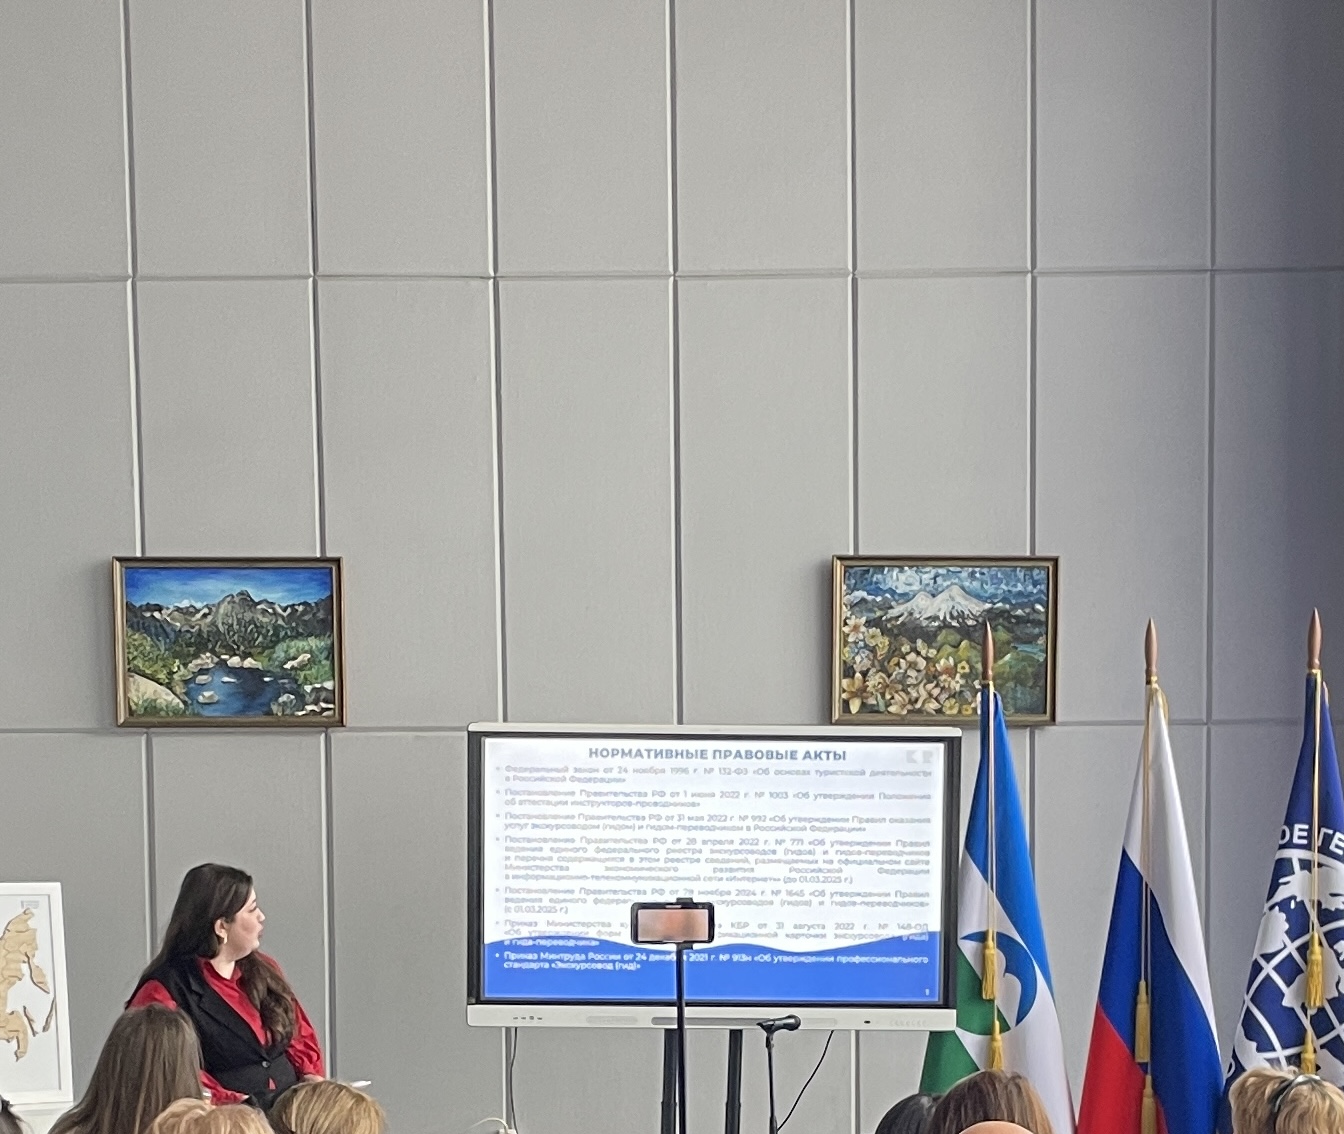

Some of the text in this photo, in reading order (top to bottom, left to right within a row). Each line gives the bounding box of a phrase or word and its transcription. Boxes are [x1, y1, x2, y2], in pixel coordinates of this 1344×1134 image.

[589, 748, 847, 761] НОРМАТИВНЫЕ ПРАВОВЫЕ АКТЫ
